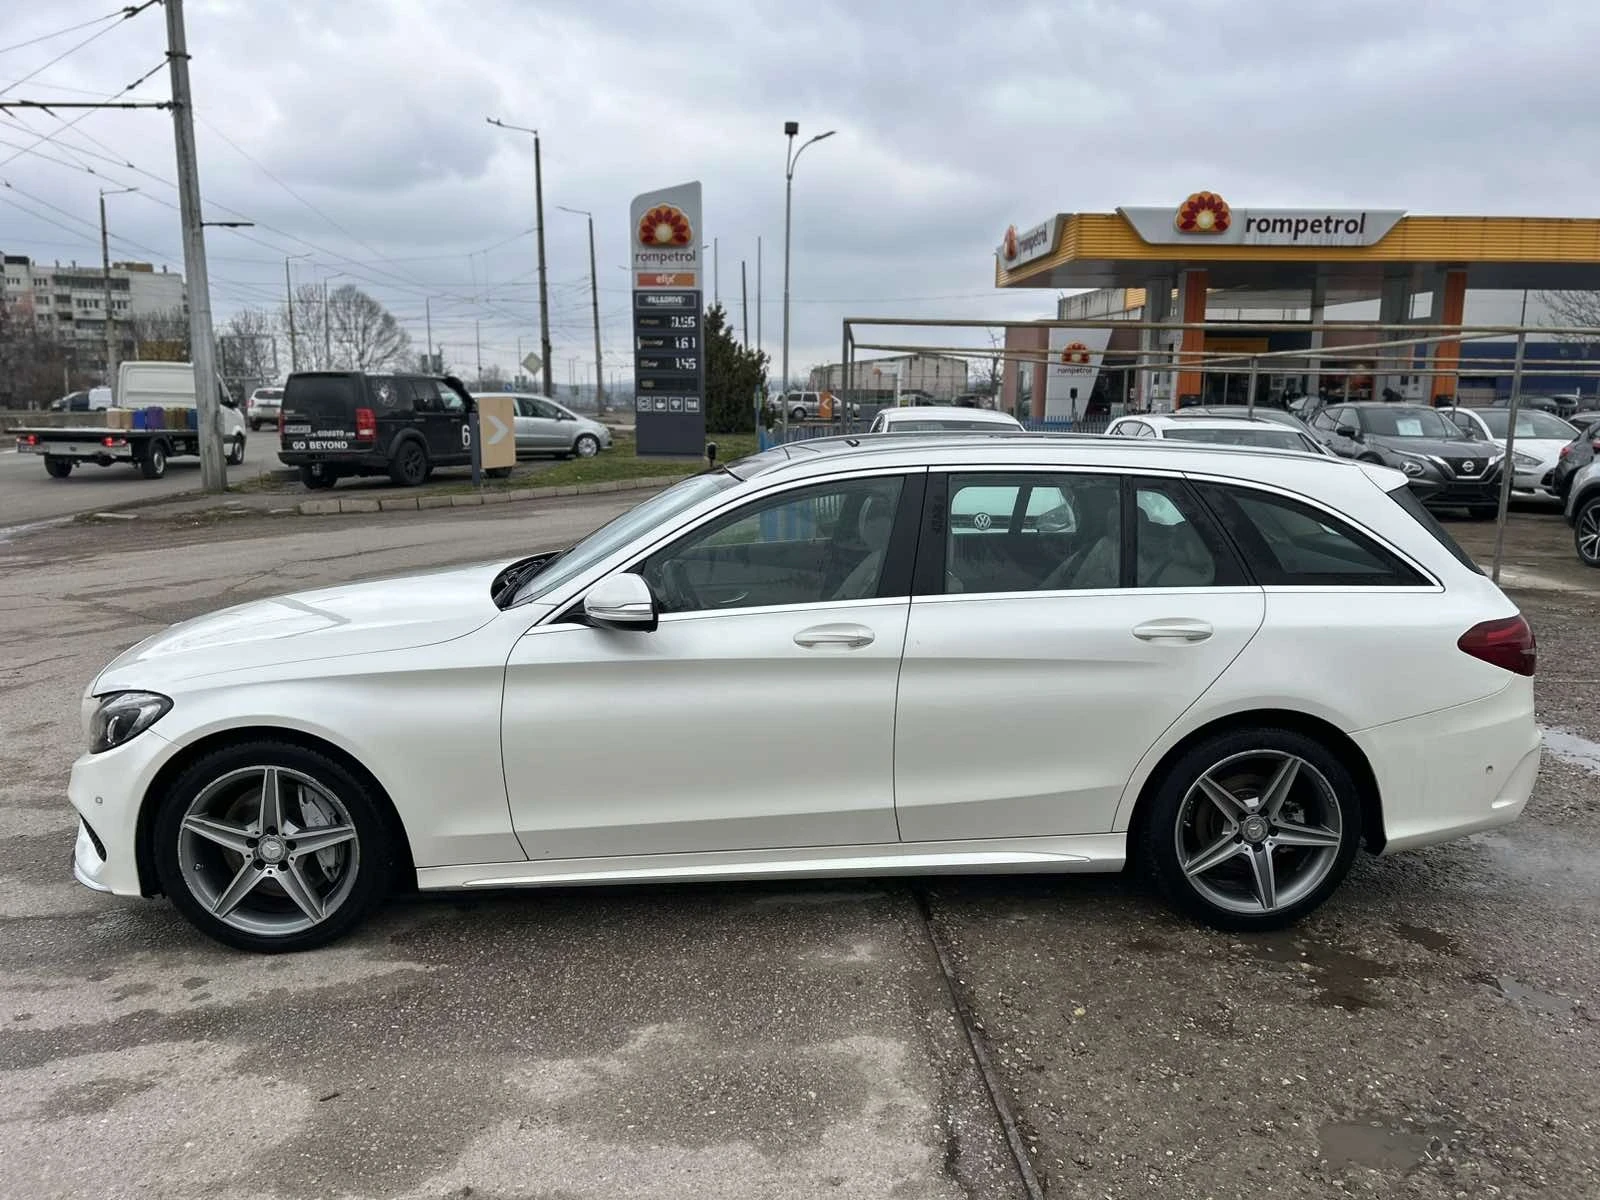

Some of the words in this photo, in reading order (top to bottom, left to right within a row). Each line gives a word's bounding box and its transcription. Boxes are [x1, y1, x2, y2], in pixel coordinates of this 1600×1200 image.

[1246, 212, 1366, 240] rompetrol
[1019, 222, 1048, 256] rompetrol
[635, 248, 696, 264] rompetrol
[292, 440, 306, 450] GO
[309, 440, 348, 450] BEYOND
[462, 424, 471, 446] 6
